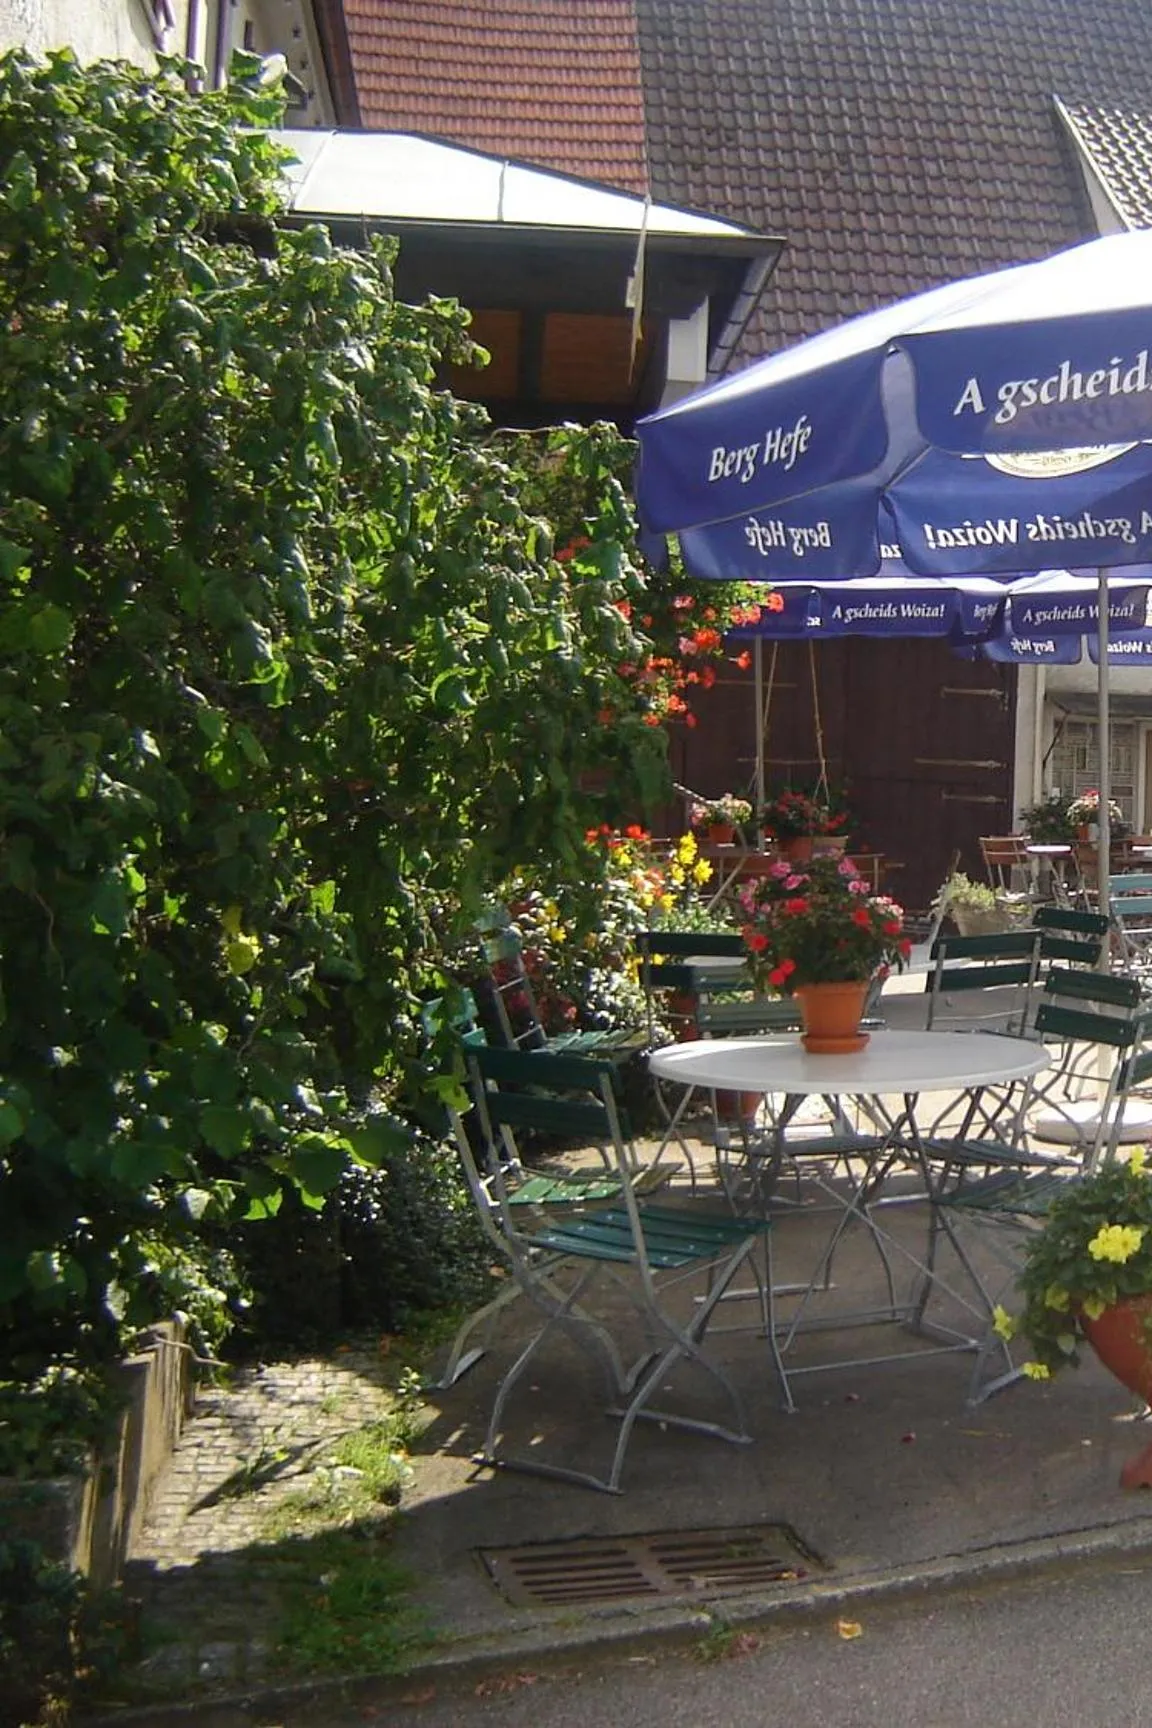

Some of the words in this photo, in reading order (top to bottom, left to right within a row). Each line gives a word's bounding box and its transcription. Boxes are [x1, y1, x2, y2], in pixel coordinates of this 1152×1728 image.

[953, 377, 985, 415] A
[708, 442, 762, 484] Berg
[762, 414, 812, 471] Hefe
[1088, 602, 1135, 619] Wiza!
